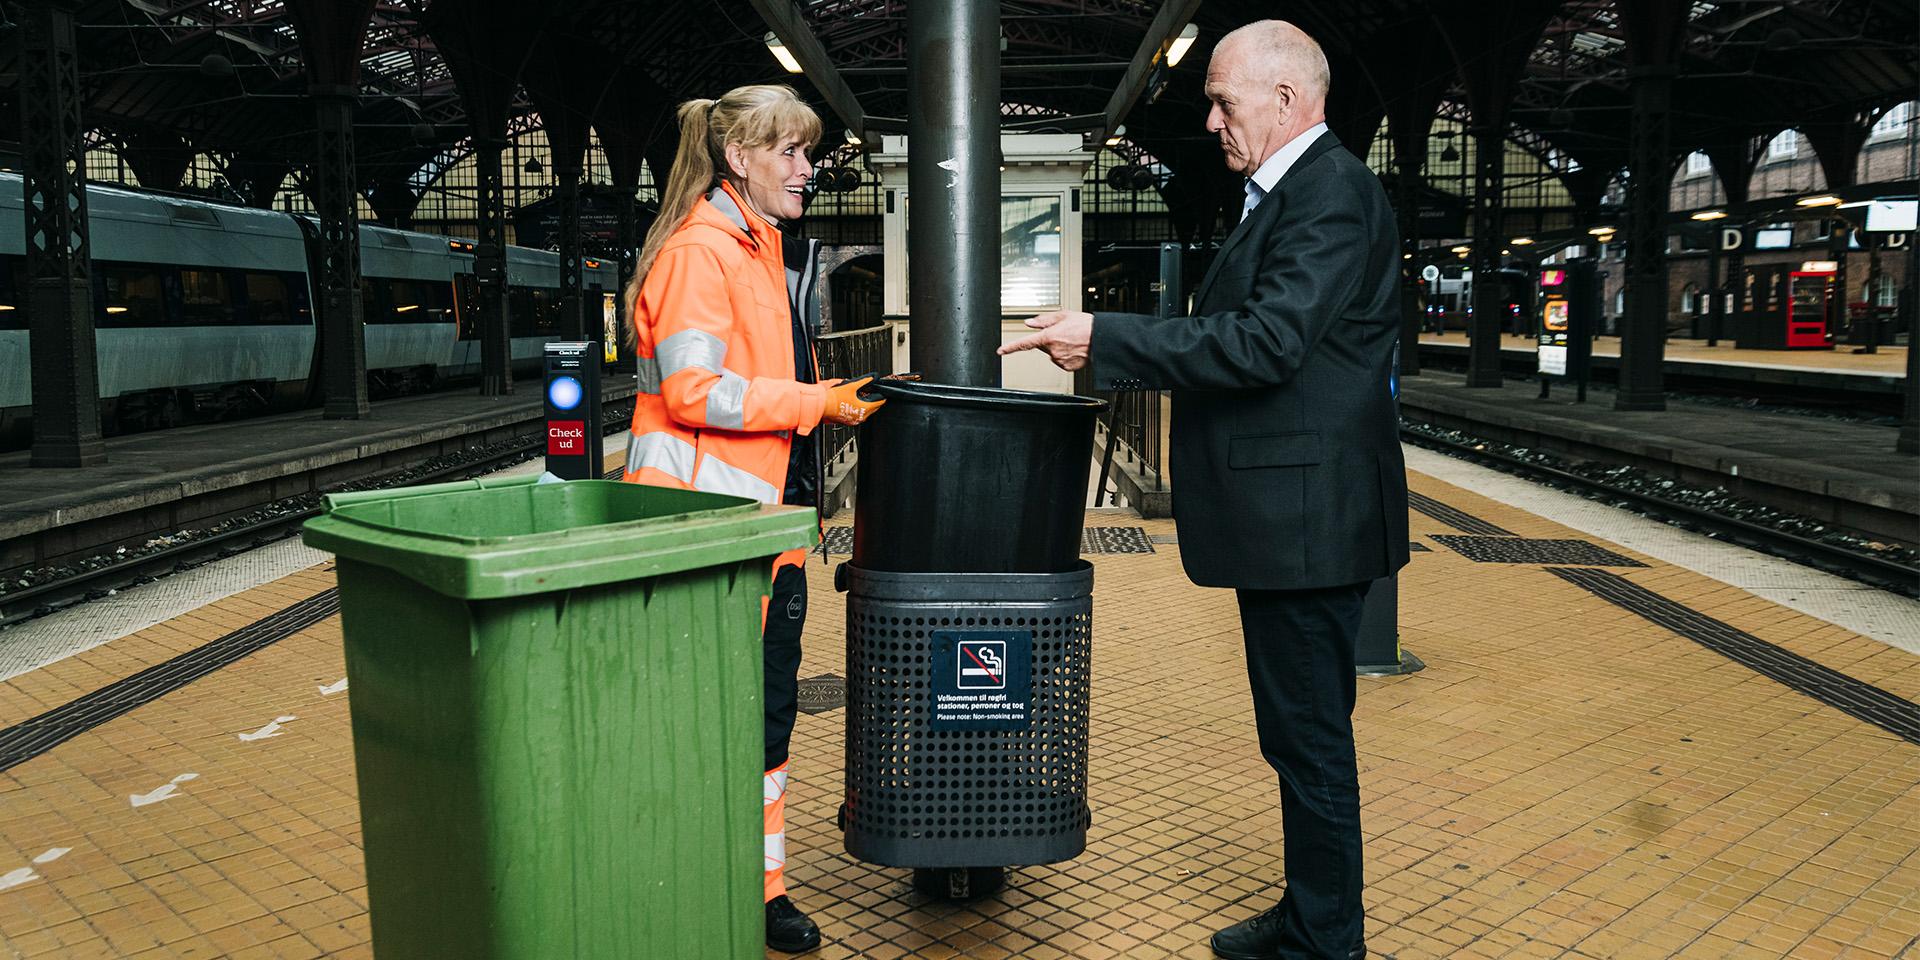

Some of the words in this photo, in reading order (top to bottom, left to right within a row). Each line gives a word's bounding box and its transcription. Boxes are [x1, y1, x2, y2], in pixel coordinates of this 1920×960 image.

[1722, 229, 1743, 251] D
[1888, 233, 1907, 248] D
[550, 428, 582, 437] Check
[559, 439, 573, 448] ud
[988, 694, 1006, 702] røgfri
